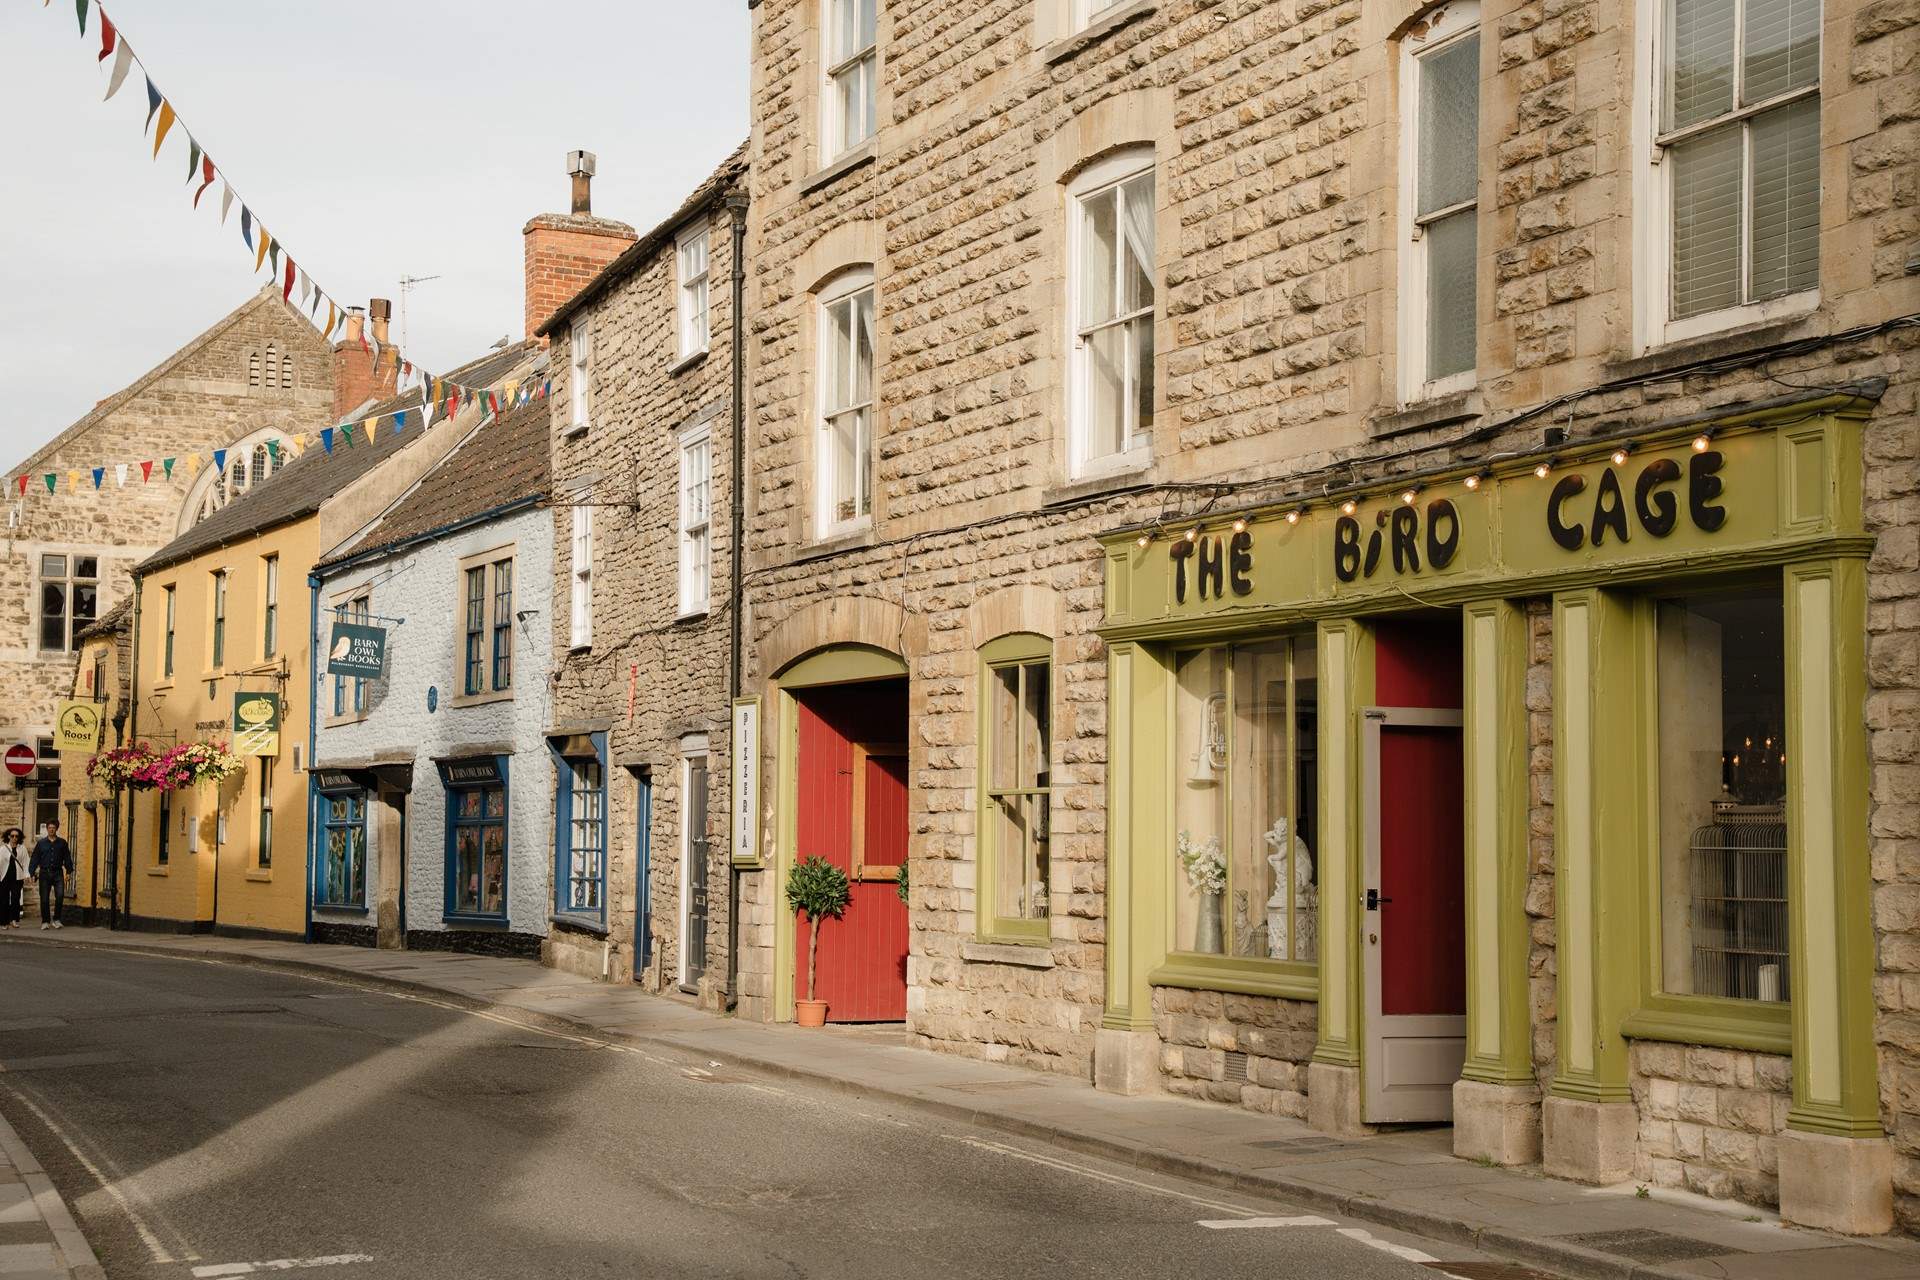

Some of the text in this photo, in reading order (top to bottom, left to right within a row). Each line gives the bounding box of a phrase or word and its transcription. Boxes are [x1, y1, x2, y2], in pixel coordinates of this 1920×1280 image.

[1169, 531, 1255, 604] THE
[1547, 451, 1728, 551] CAGE
[354, 638, 379, 648] BARN
[354, 646, 377, 657] OWL
[348, 654, 381, 666] BOOKS
[64, 729, 92, 740] Roost
